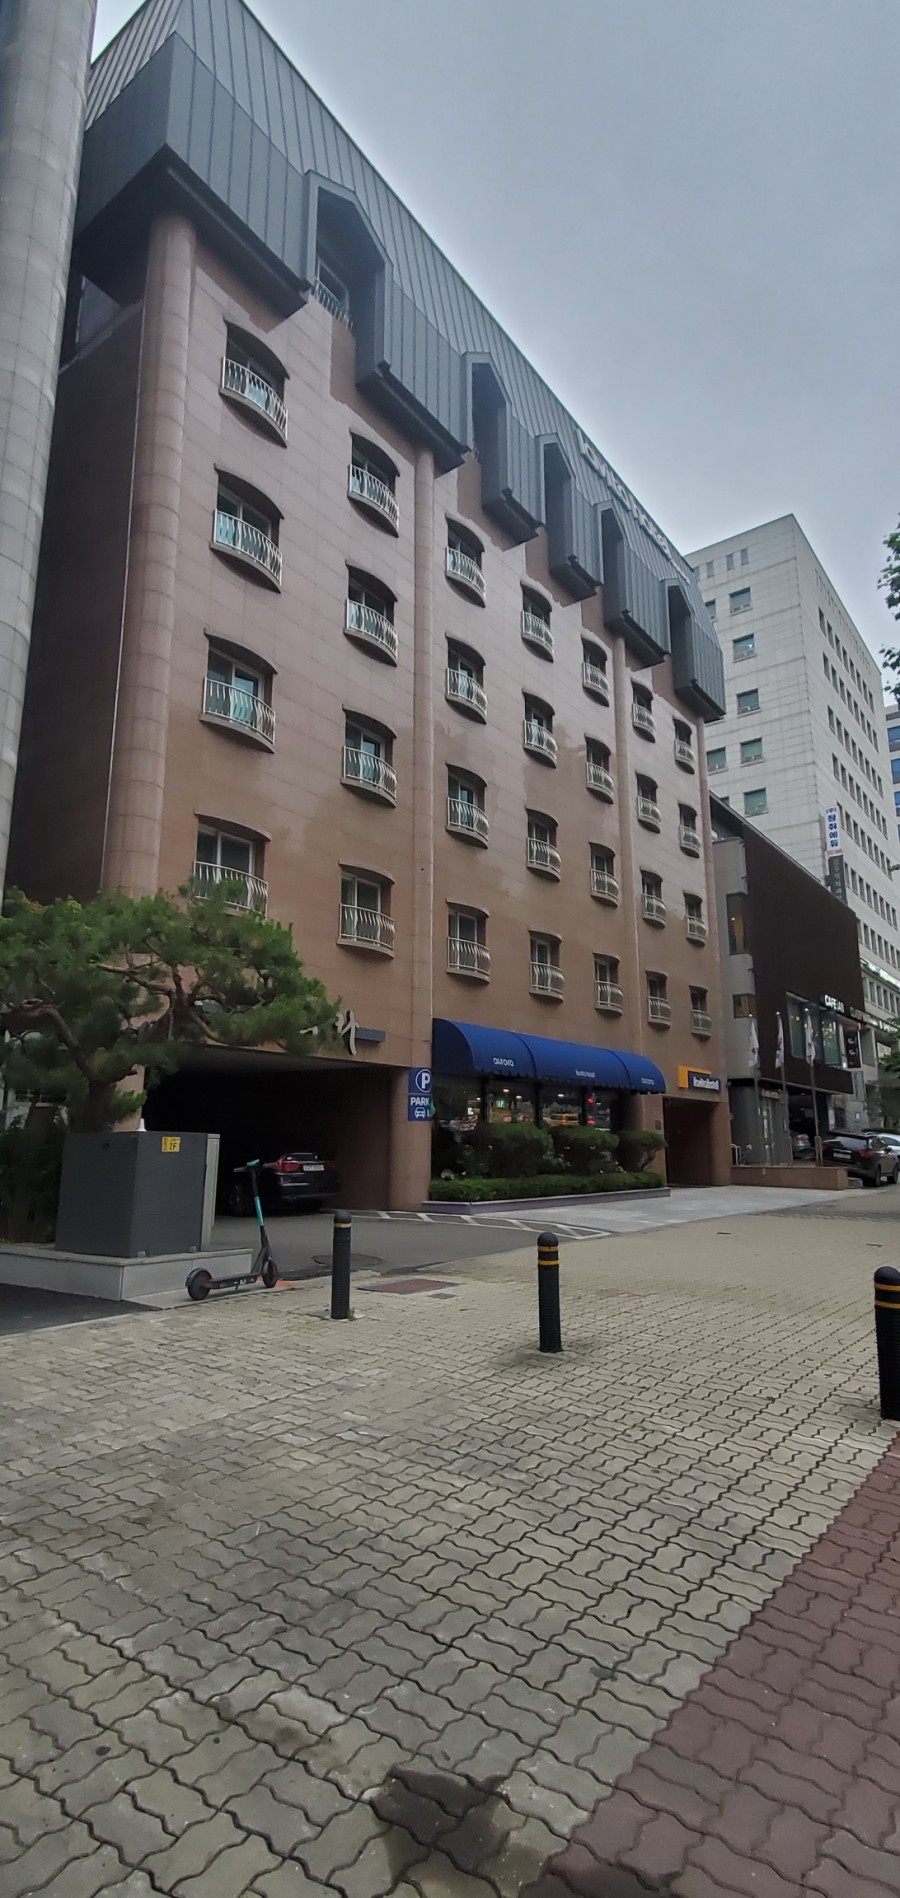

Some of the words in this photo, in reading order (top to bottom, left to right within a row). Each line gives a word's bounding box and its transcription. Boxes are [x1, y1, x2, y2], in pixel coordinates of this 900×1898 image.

[824, 994, 837, 1010] CAFE
[492, 1057, 514, 1067] aurora
[421, 1072, 431, 1089] P
